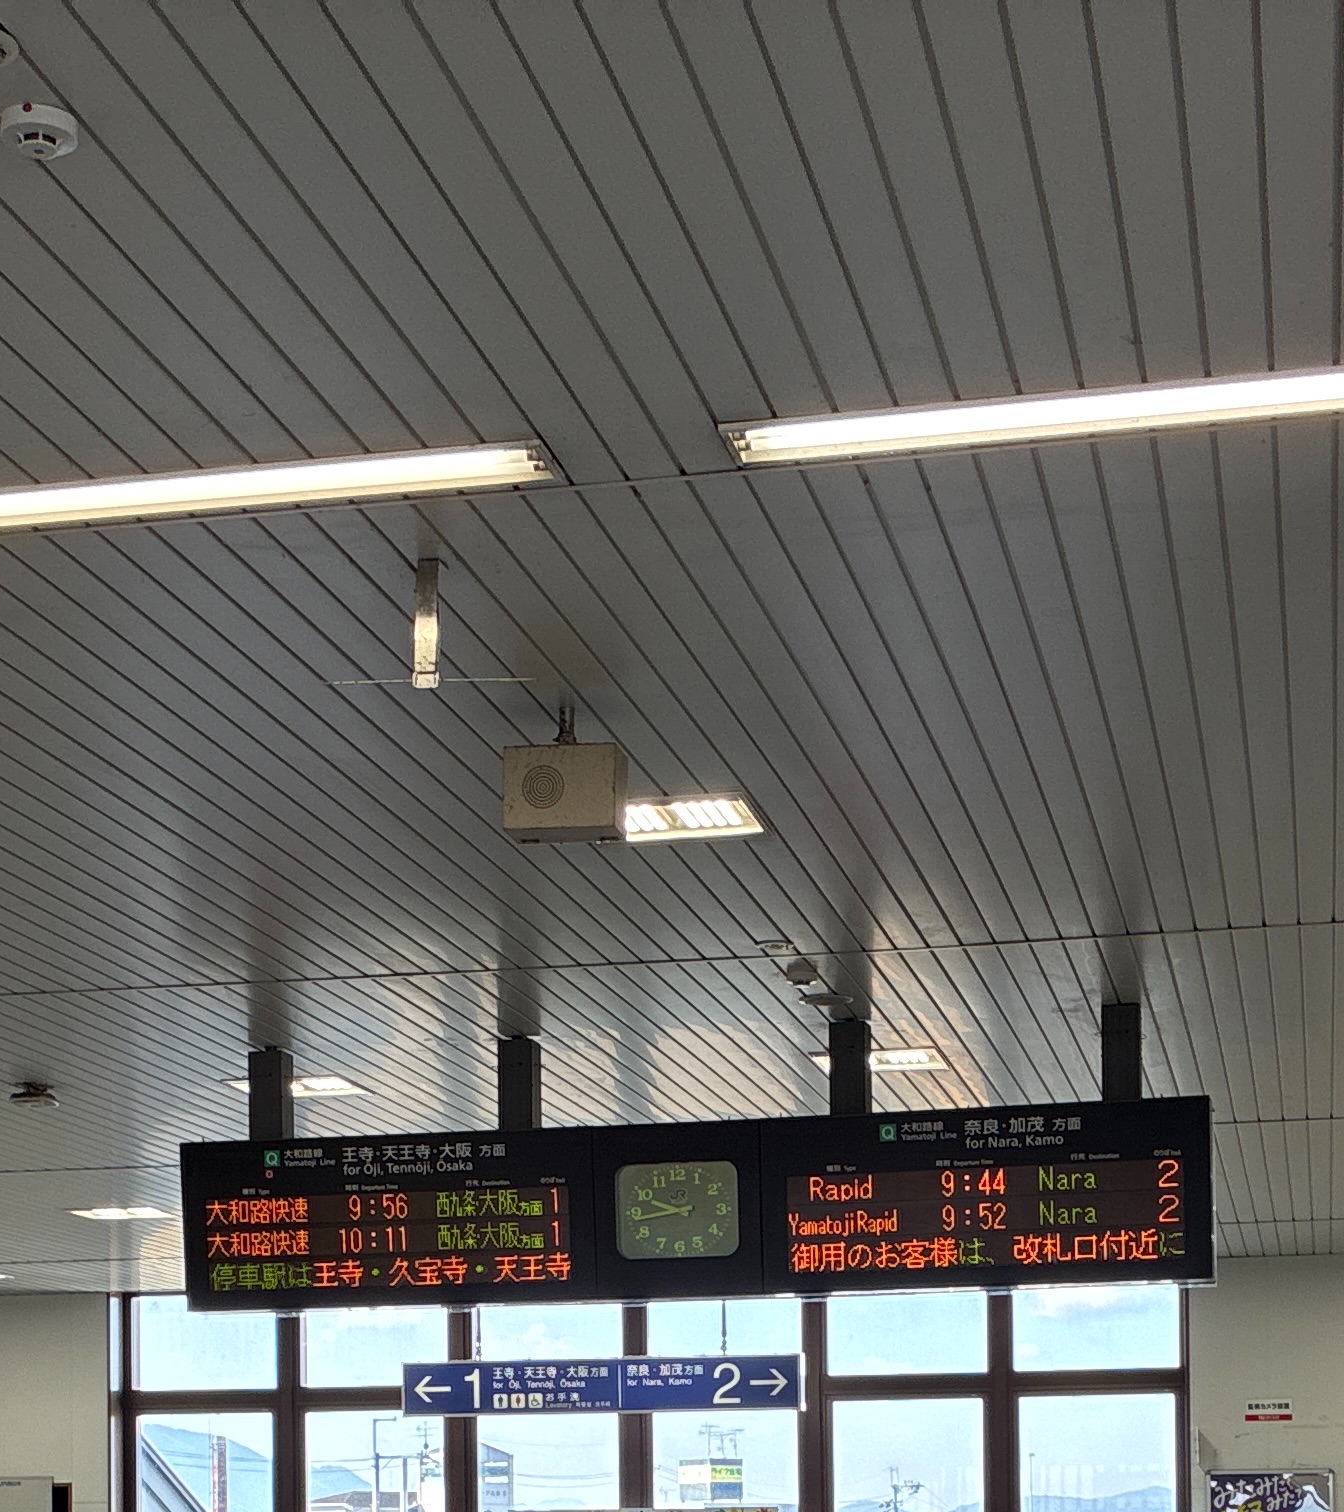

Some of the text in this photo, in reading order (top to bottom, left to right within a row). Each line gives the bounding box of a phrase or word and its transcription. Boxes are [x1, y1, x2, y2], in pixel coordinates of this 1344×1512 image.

[940, 1130, 958, 1139] Line
[966, 1134, 1064, 1149] for Nara, Kamo
[320, 1157, 336, 1166] Line
[343, 1164, 361, 1177] for
[669, 1169, 686, 1181] 12
[653, 1176, 666, 1188] 11
[694, 1173, 701, 1184] 1
[809, 1159, 1180, 1202] Rapid 9:44 Nara 2
[637, 1189, 653, 1200] 10
[708, 1183, 718, 1195] 2
[205, 1197, 309, 1228] 大和路快速
[348, 1193, 409, 1222] 9:56
[550, 1187, 559, 1214] 1
[631, 1207, 642, 1220] 9
[716, 1203, 727, 1215] 3
[941, 1203, 1007, 1231] 9:52
[1039, 1203, 1098, 1226] Nara
[1158, 1194, 1181, 1223] 2
[639, 1226, 650, 1238] 8
[708, 1223, 719, 1235] 4
[207, 1229, 310, 1260] 大和路快速
[338, 1225, 409, 1254] 10:11
[551, 1220, 560, 1247] 1
[657, 1238, 666, 1249] 7
[692, 1236, 703, 1248] 5
[674, 1241, 685, 1252] 6
[464, 1367, 481, 1409] 1
[492, 1380, 504, 1389] for
[627, 1378, 638, 1388] for
[668, 1376, 692, 1386] Kamo
[713, 1362, 742, 1404] 2
